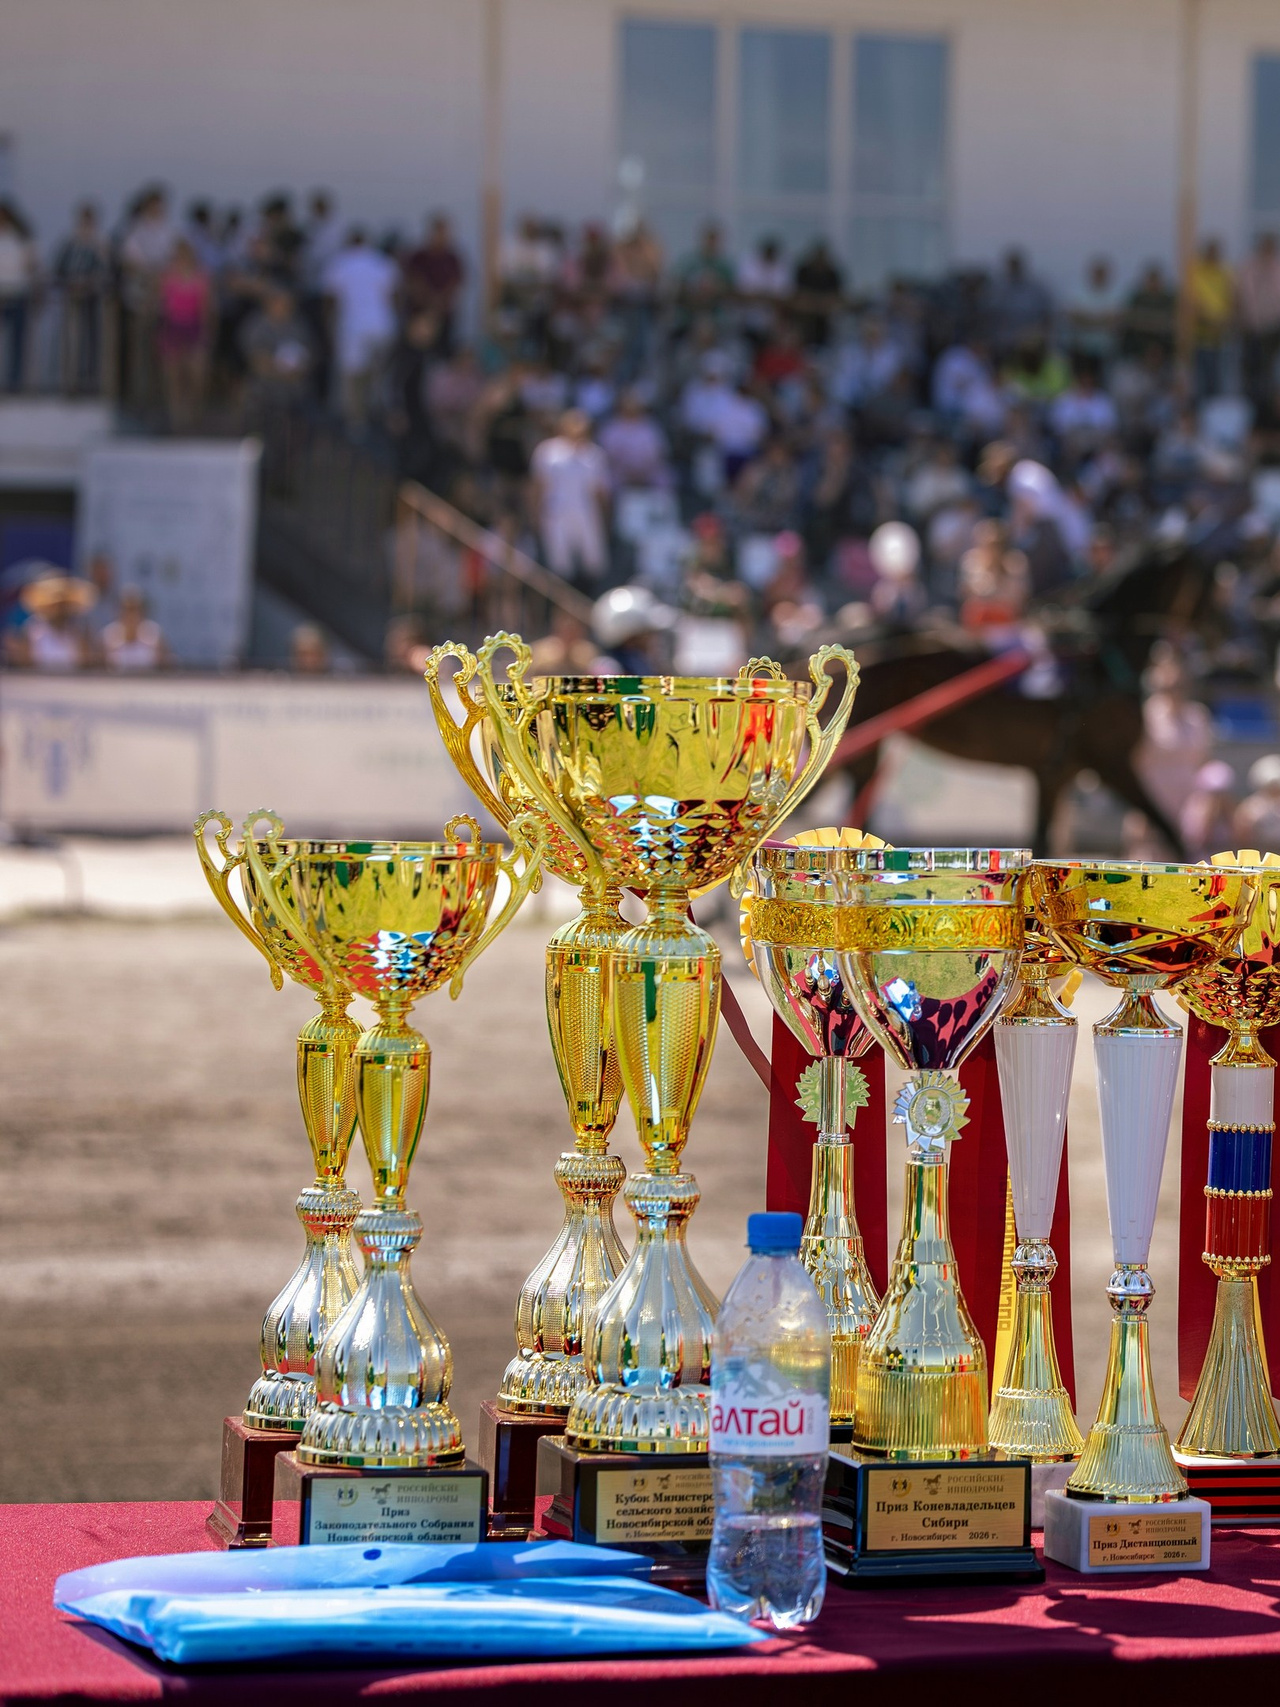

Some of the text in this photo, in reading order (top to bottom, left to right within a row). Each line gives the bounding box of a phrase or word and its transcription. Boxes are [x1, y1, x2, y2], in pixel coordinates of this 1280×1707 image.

[712, 1399, 804, 1437] алтай
[676, 1473, 712, 1481] РОССИЙСК
[947, 1473, 1005, 1484] РОССИЙСКИЕ
[397, 1483, 458, 1493] РОССИЙСКИЕ
[947, 1485, 1004, 1494] ИППОДРОМЫ
[396, 1494, 458, 1504] ИППОДРОМЫ
[615, 1492, 714, 1505] Кубок Министерс
[616, 1506, 672, 1518] сельского
[876, 1500, 1016, 1514] Приз Коневладельцев
[381, 1508, 410, 1518] Приз
[315, 1519, 475, 1531] Законодательного Собрания
[606, 1518, 694, 1530] Новосибирской
[922, 1518, 969, 1530] Сибири
[1145, 1518, 1187, 1526] РОССИЙСКИЕ
[634, 1530, 685, 1538] Новосибирск
[1145, 1526, 1187, 1534] ИППОДРОМЫ
[327, 1532, 462, 1542] Новосибирской области
[891, 1534, 898, 1542] г.
[900, 1533, 958, 1543] Новосибирск
[968, 1532, 990, 1540] 2026
[1092, 1537, 1198, 1551] Приз Дистанционный
[1110, 1553, 1155, 1562] Новосибирск
